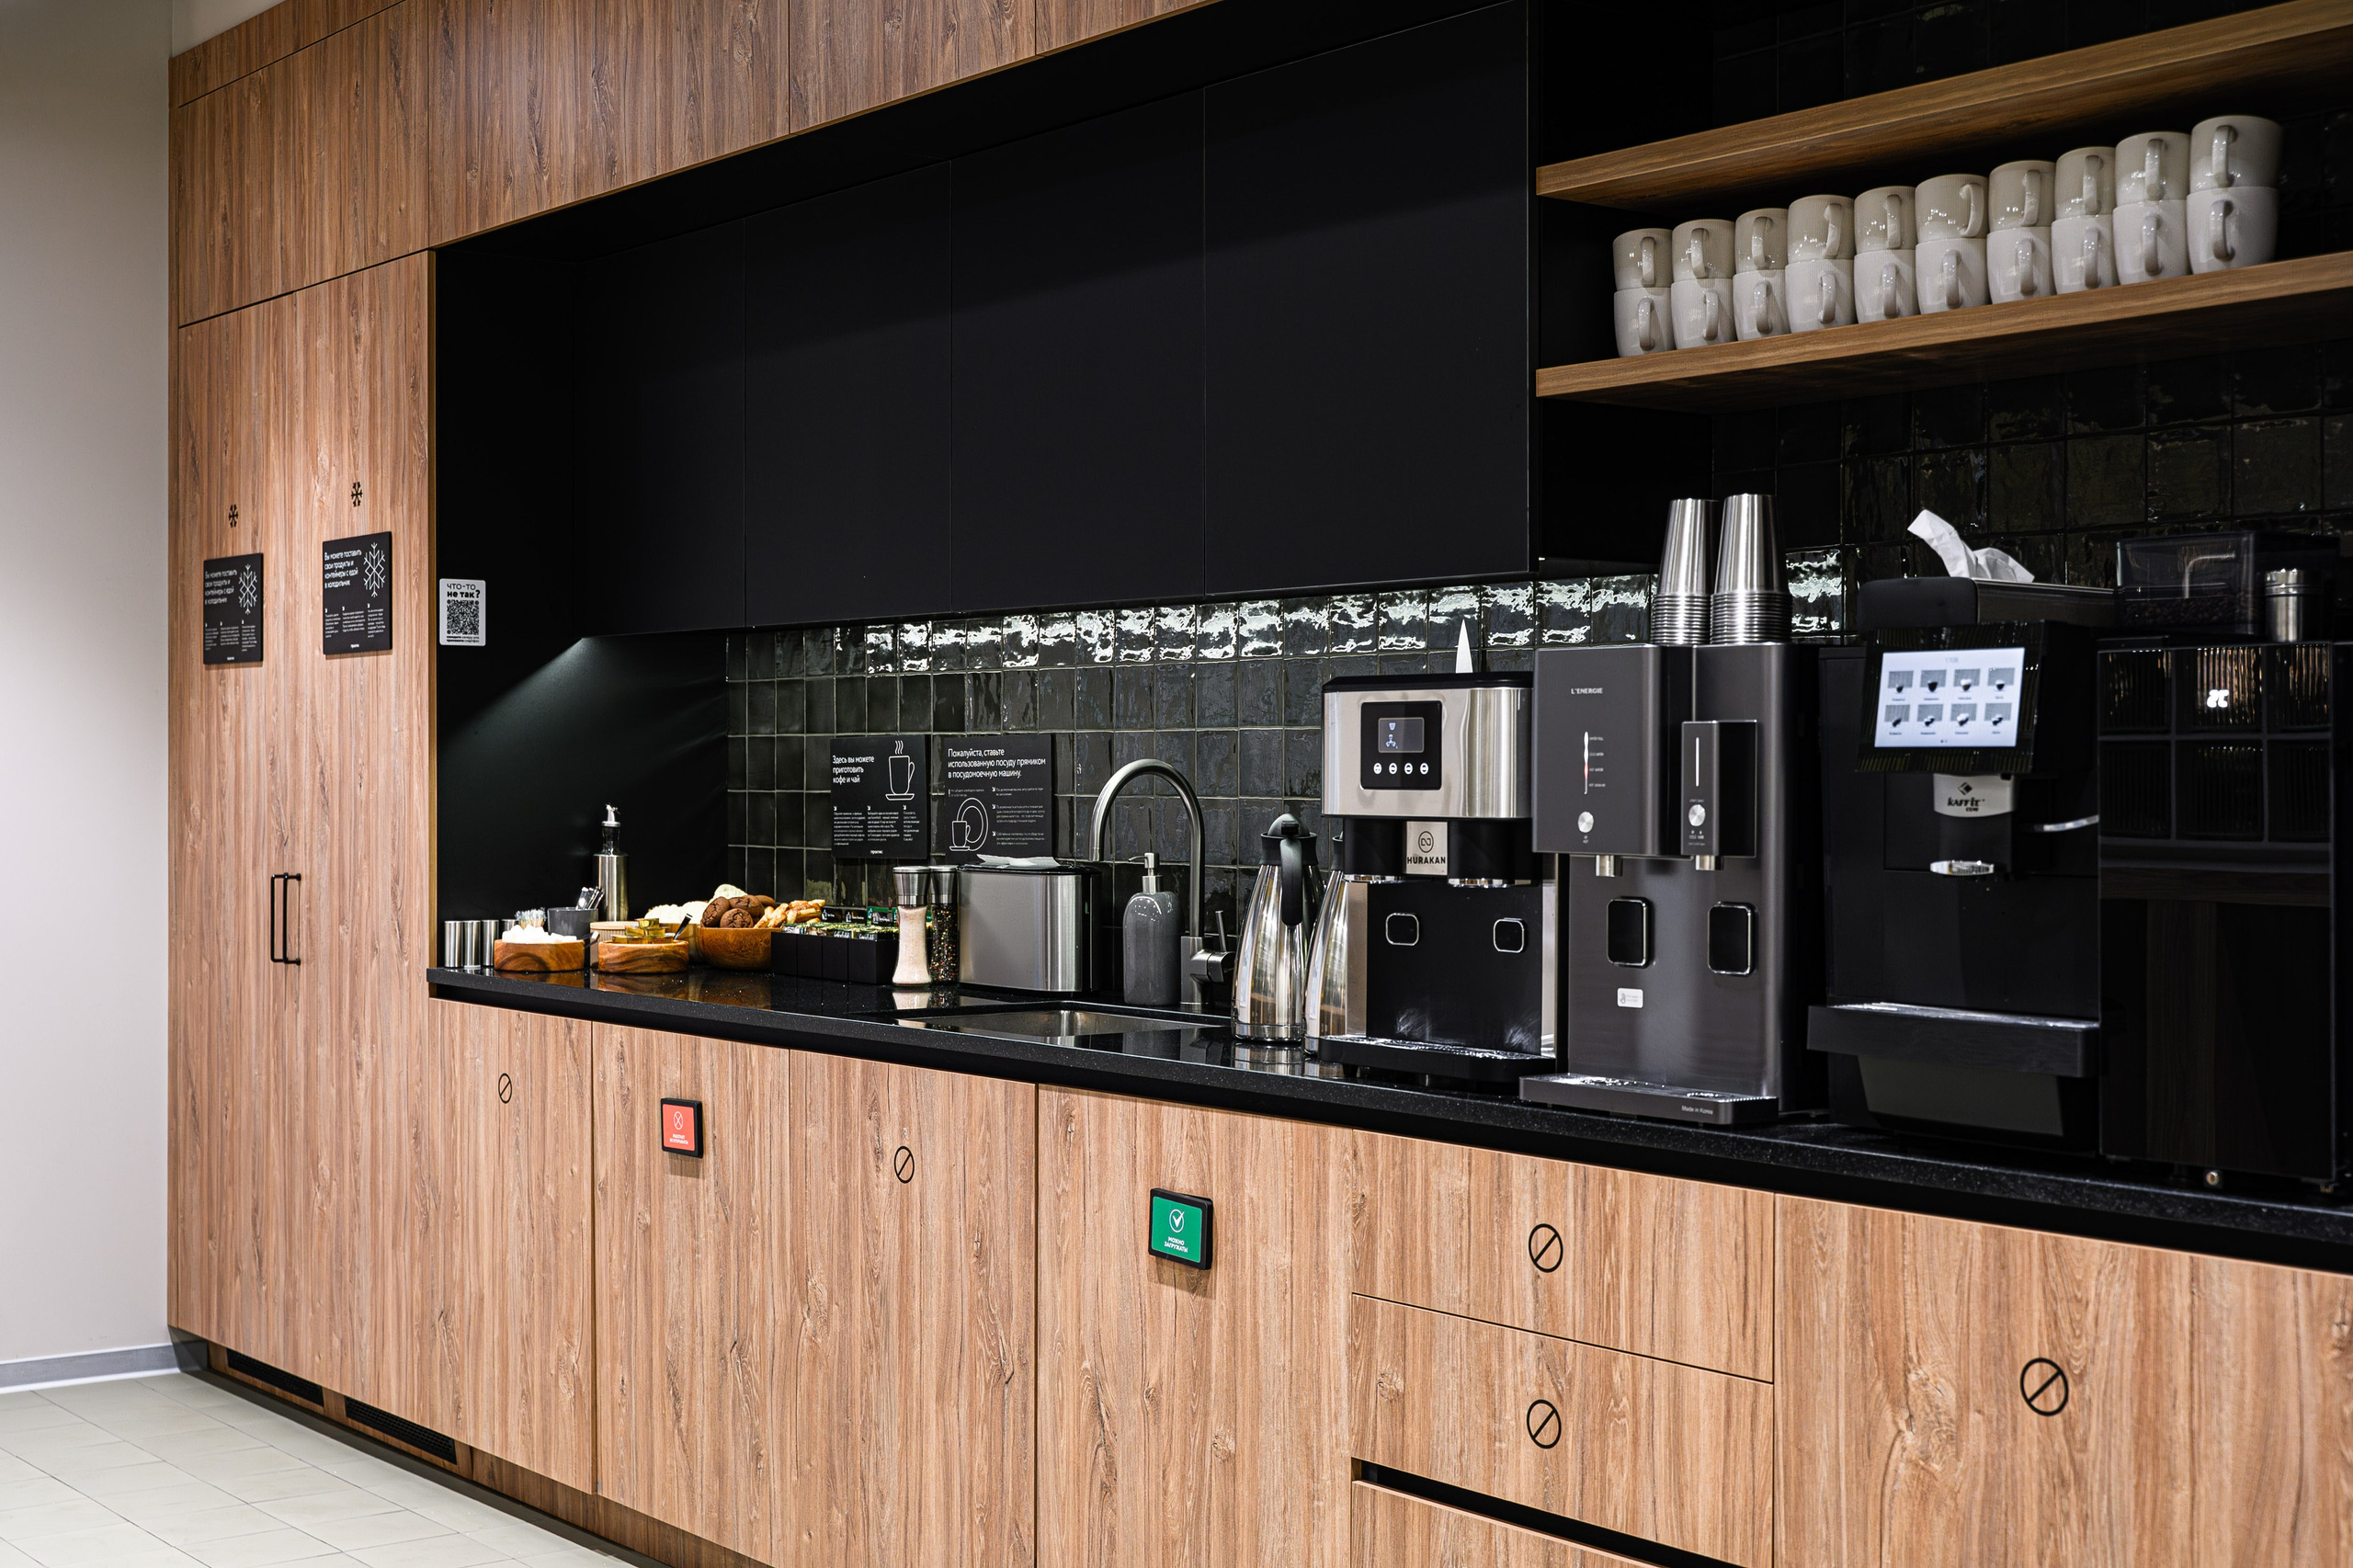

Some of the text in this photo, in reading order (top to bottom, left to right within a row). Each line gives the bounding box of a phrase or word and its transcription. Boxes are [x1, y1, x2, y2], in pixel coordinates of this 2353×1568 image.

[948, 748, 1005, 758] Пожалуйста, ставьте
[832, 755, 847, 764] Здесь
[948, 758, 1046, 768] использованную посуду прямиком
[832, 767, 864, 775] приготовить
[952, 770, 997, 779] посудомоечную
[998, 770, 1022, 778] машину.
[833, 775, 846, 785] кофе
[851, 774, 860, 783] чай
[1167, 1236, 1185, 1245] МОЖНО
[1164, 1241, 1188, 1253] ЗАГРУЖАТЬ
